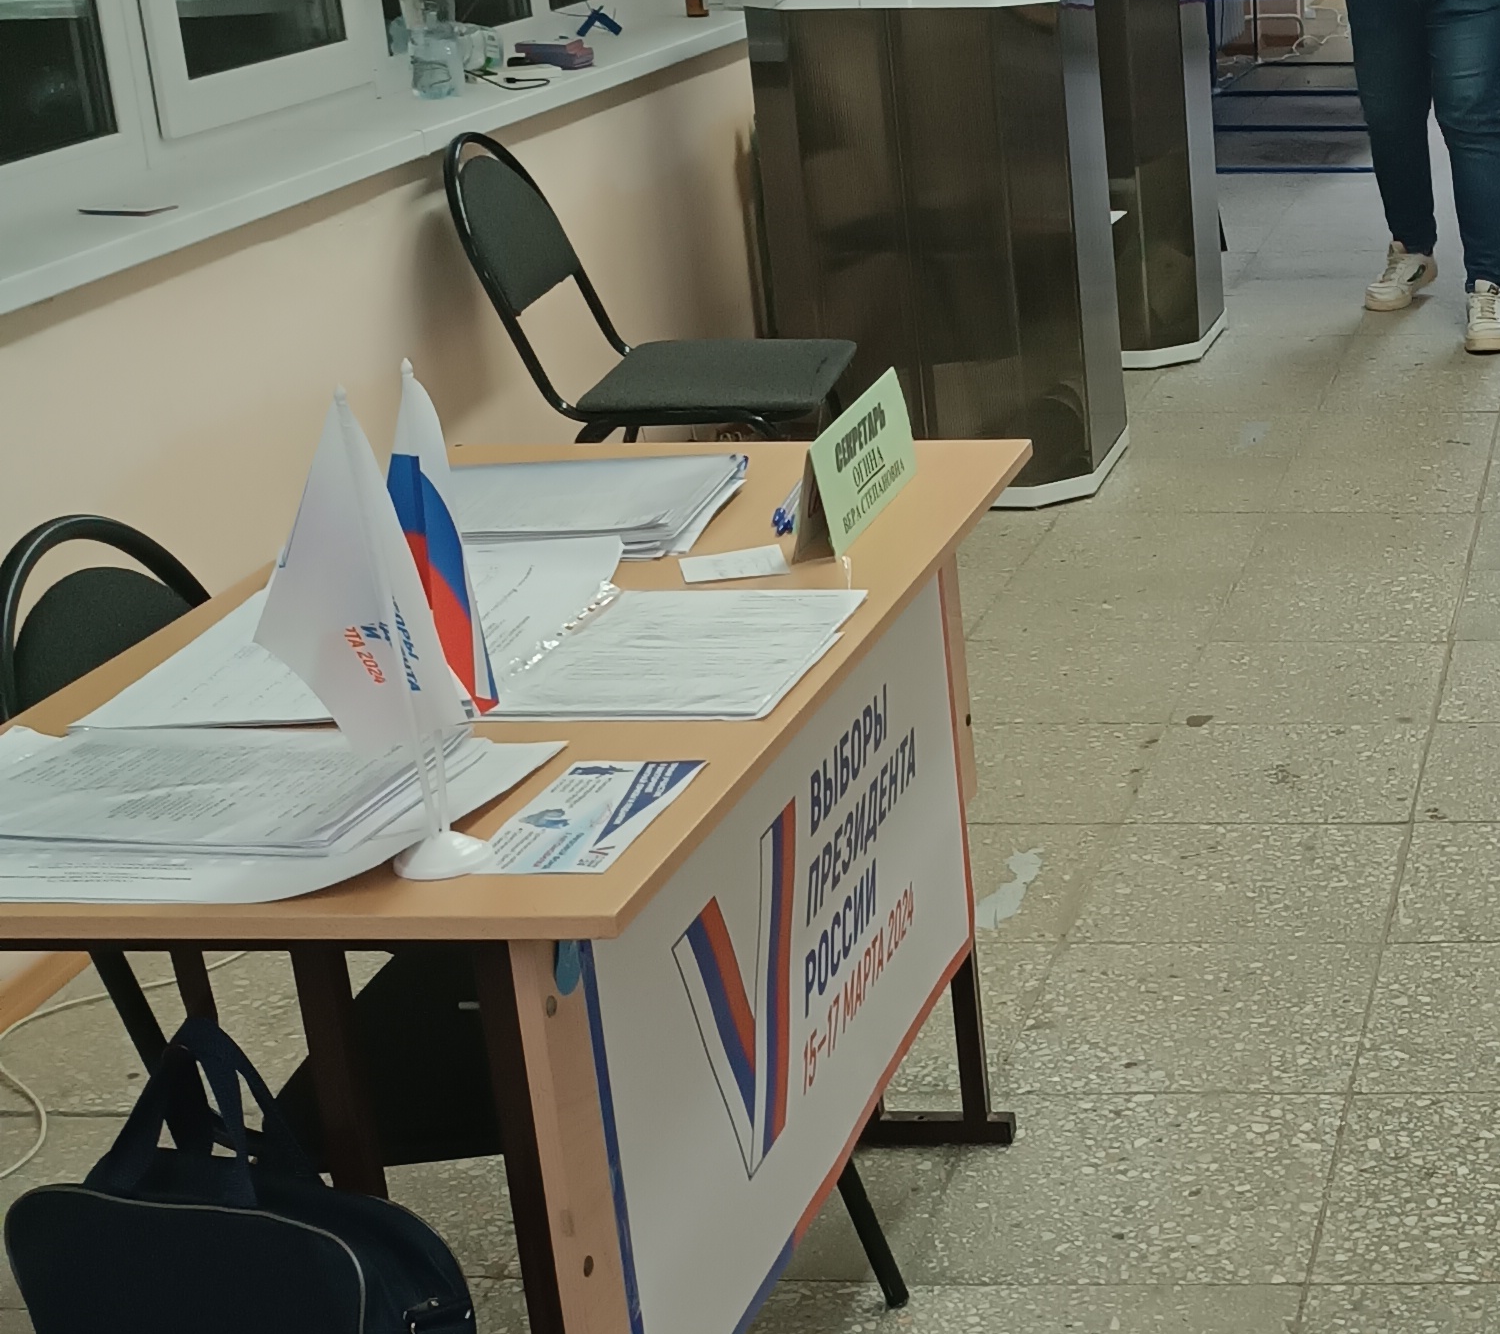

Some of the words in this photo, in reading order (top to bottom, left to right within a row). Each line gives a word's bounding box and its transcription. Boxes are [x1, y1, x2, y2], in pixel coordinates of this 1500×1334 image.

[834, 402, 886, 473] СЕКРЕТАРЬ
[852, 445, 885, 488] ОГИНА
[842, 505, 861, 534] ВЕРА
[860, 458, 905, 515] СТЕПАНОВНА
[357, 650, 387, 684] 2024
[810, 683, 887, 837] ВЫБОРЫ
[806, 726, 916, 928] ПРЕЗИДЕНТА
[803, 992, 840, 1096] 15–17
[842, 927, 884, 1034] МАРТА
[887, 880, 914, 964] 2024
[805, 857, 877, 1018] РОССИИ
